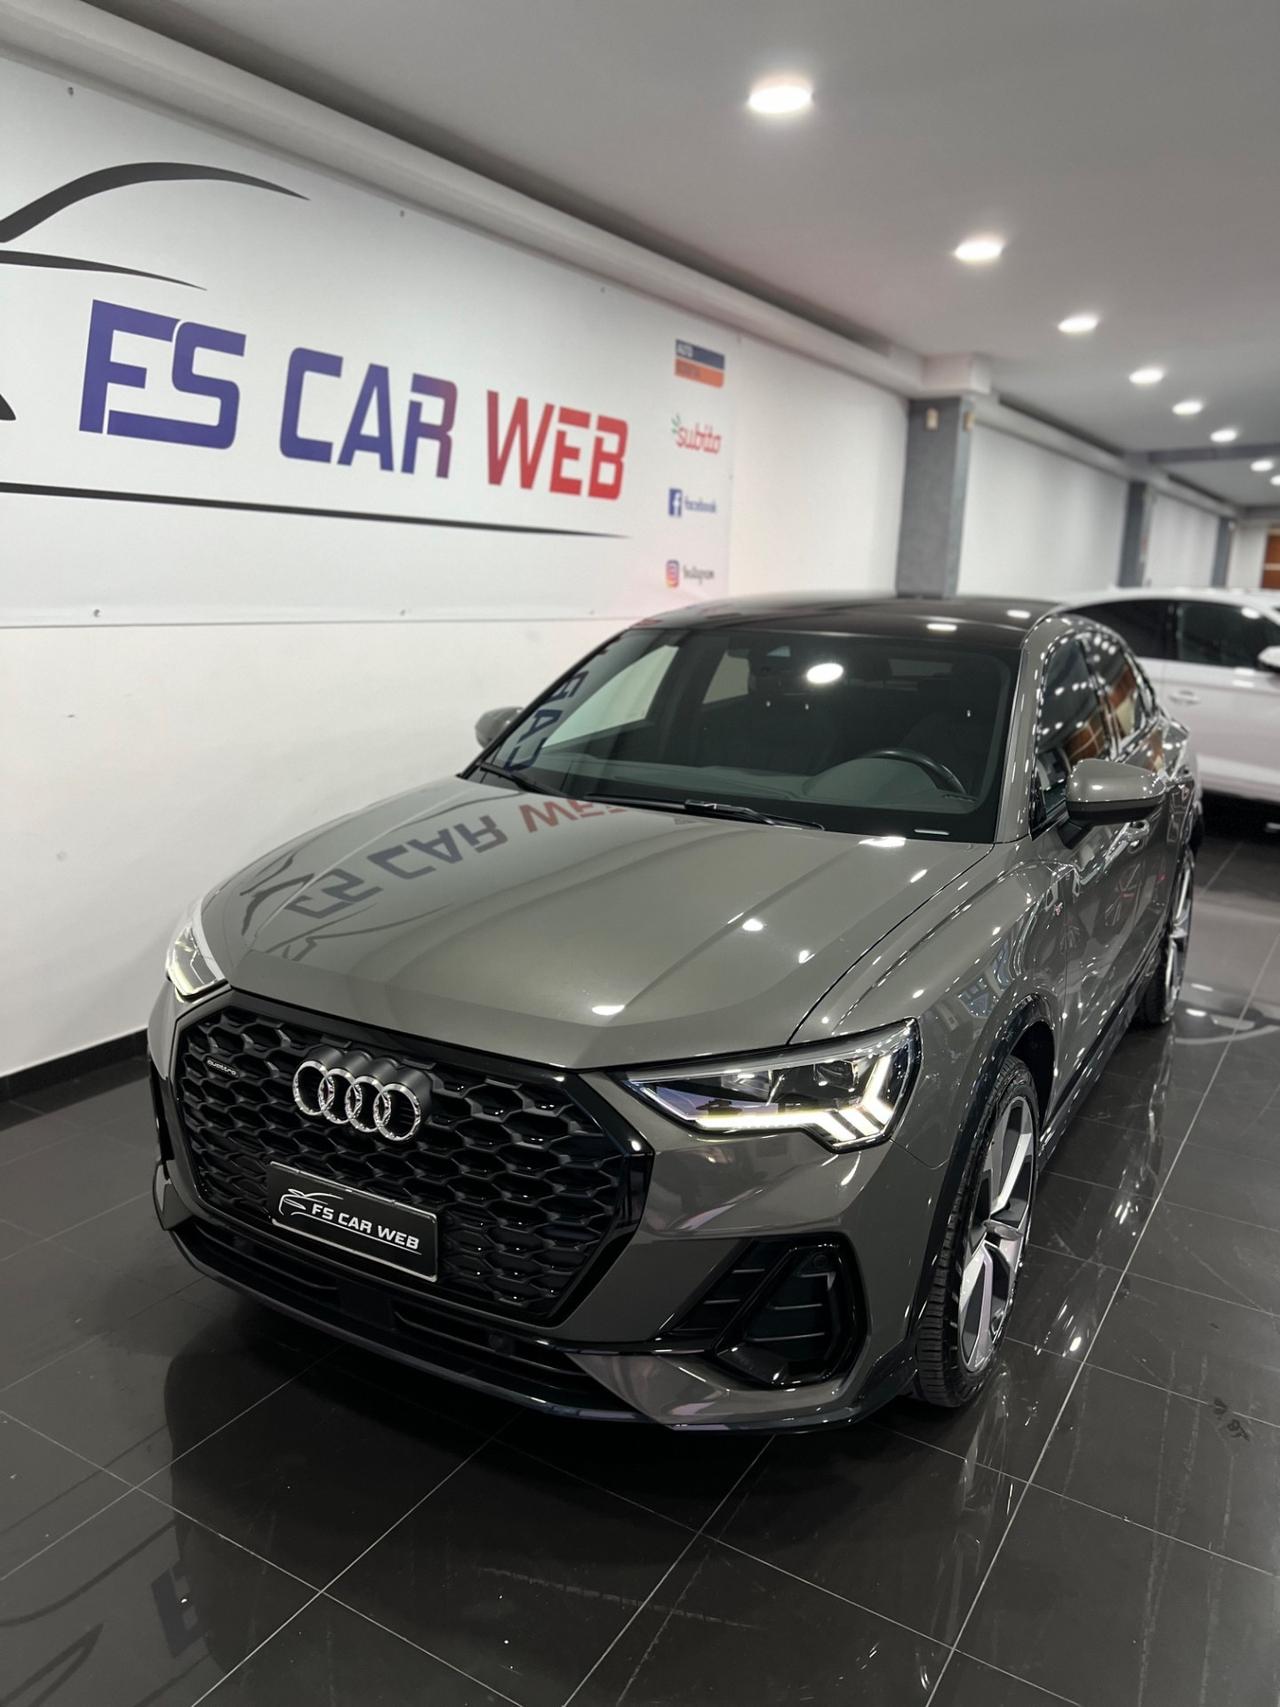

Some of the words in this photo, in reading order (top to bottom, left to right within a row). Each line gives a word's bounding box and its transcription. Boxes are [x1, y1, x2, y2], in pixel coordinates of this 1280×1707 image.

[79, 299, 247, 450] FS
[279, 346, 459, 479] CAR
[486, 389, 629, 502] WEB
[311, 1203, 335, 1221] FS
[337, 1212, 374, 1235] CAR
[377, 1225, 420, 1250] WEB
